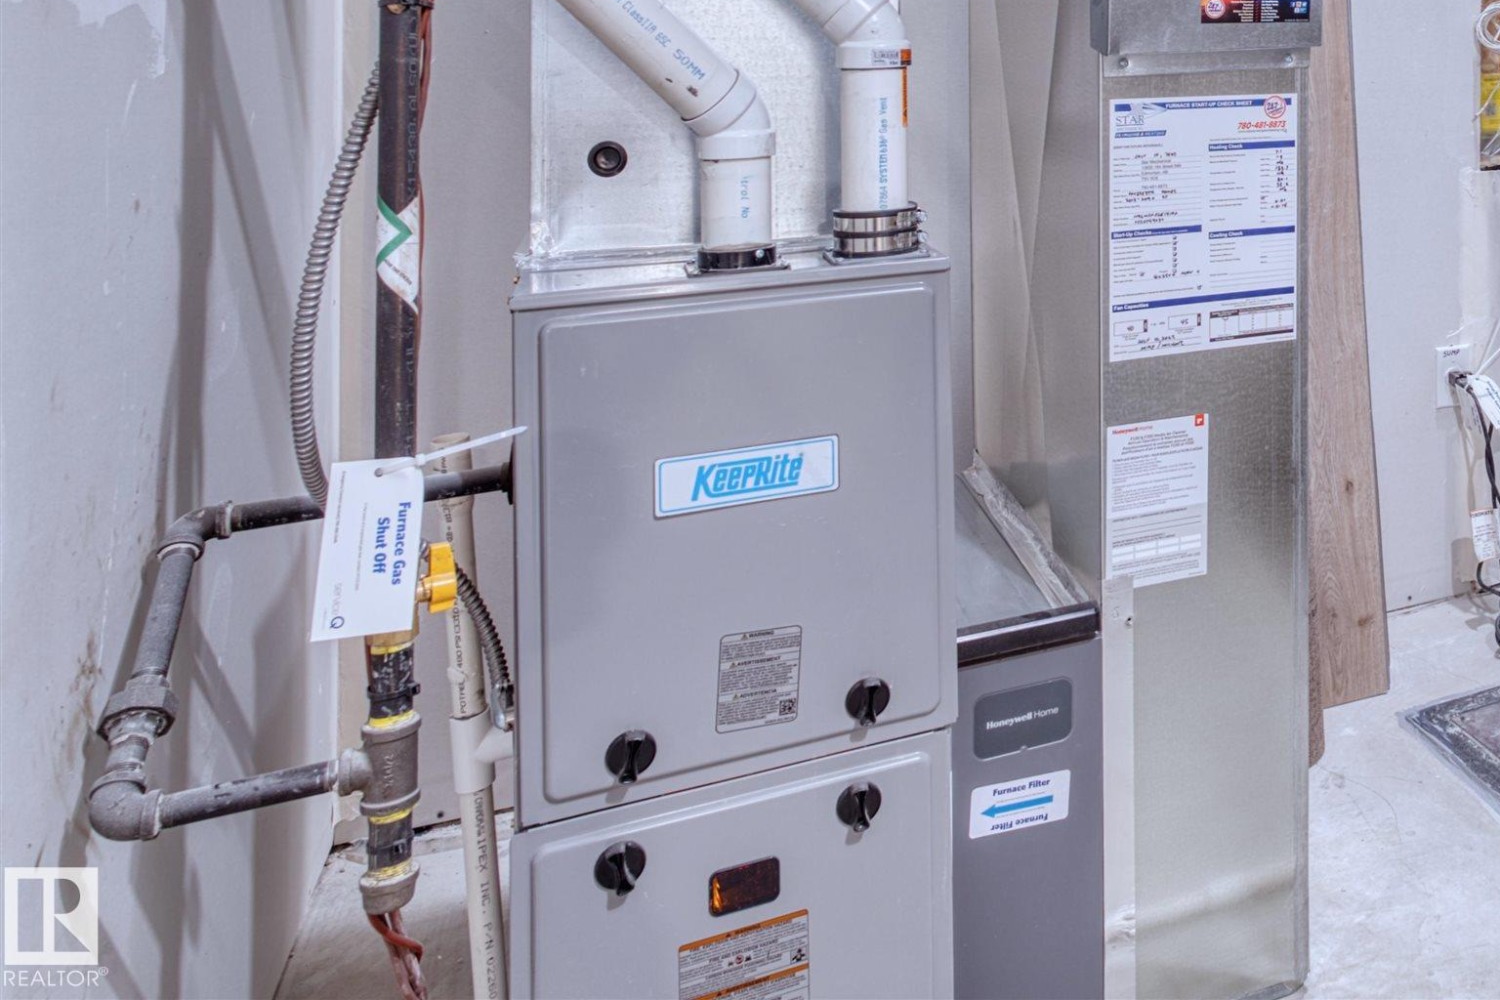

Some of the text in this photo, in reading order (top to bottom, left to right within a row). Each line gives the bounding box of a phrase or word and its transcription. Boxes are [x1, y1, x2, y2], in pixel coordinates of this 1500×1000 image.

[671, 47, 707, 81] 50MM
[879, 97, 887, 114] Vent
[1115, 115, 1145, 125] STAR
[1238, 121, 1286, 129] 780-481-8873
[740, 207, 748, 218] No
[1112, 426, 1138, 435] Honeywell
[691, 452, 804, 501] KeepRite
[372, 516, 390, 573] Shut Off
[390, 500, 412, 585] Furnace Gas
[736, 656, 781, 666] AVERTISSEMENT
[986, 706, 1059, 730] Honeywell Home
[991, 778, 1051, 796] Furnace Filter
[989, 812, 1049, 831] Furnace Filter
